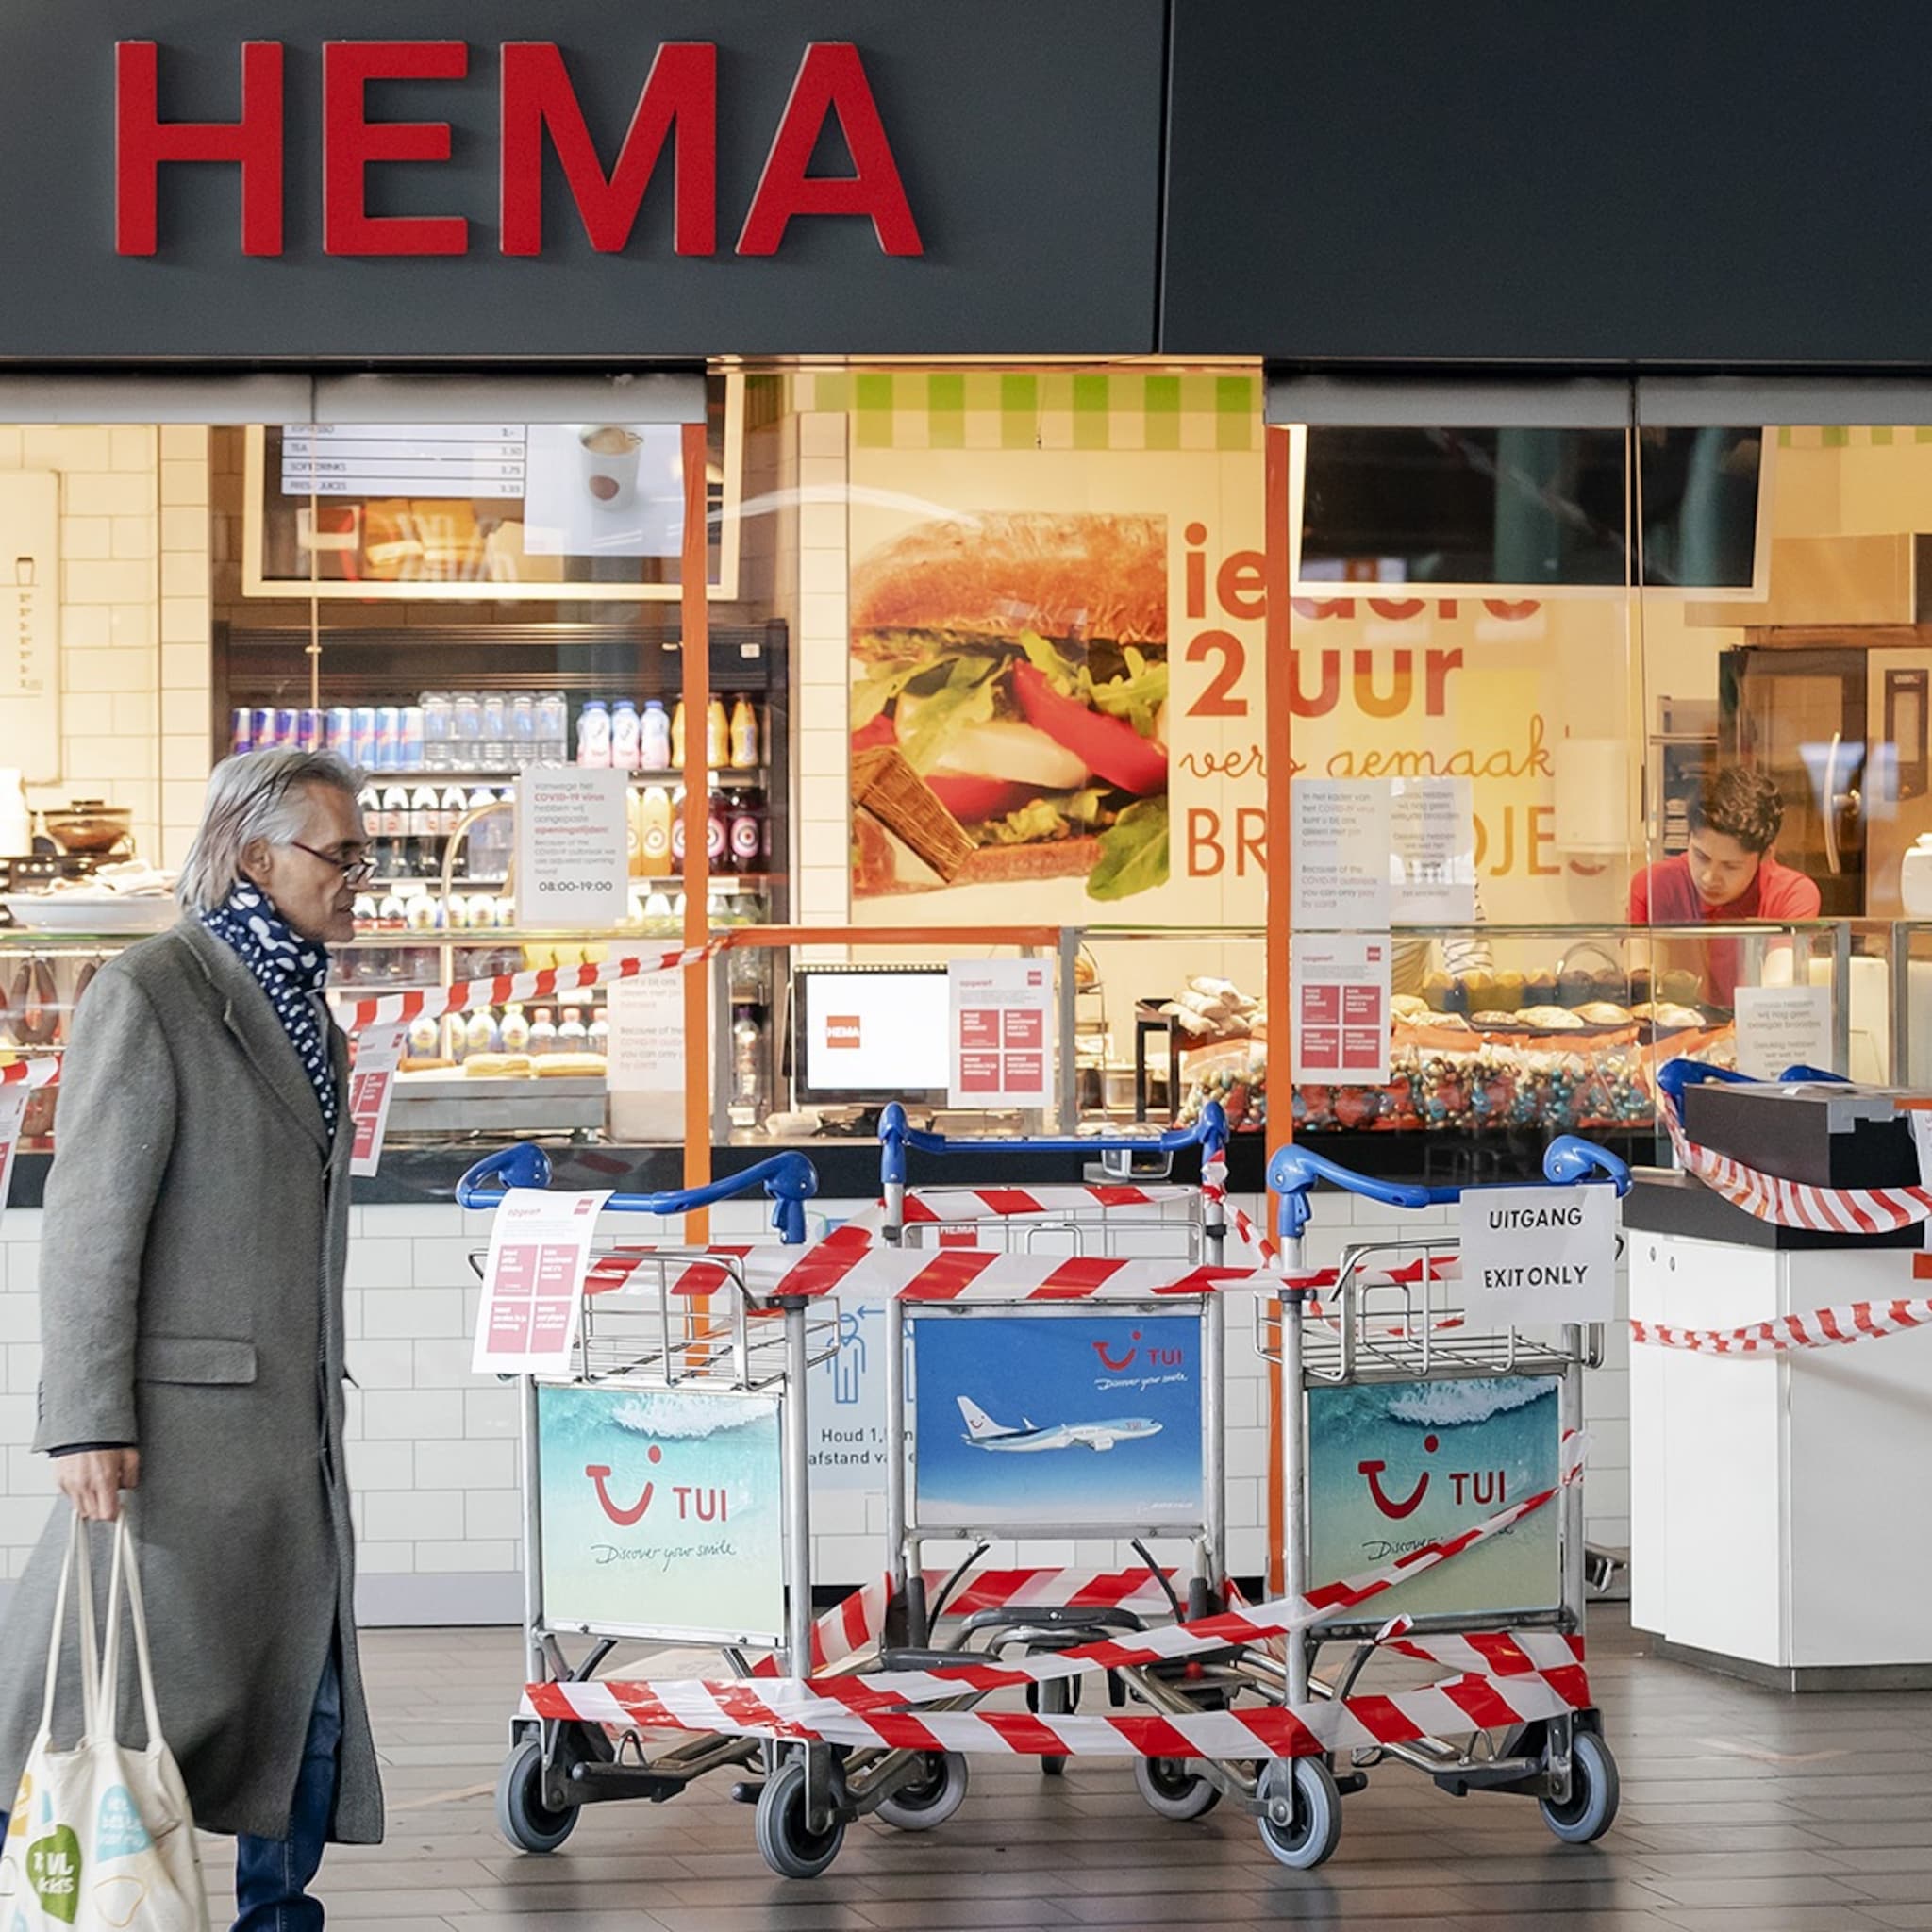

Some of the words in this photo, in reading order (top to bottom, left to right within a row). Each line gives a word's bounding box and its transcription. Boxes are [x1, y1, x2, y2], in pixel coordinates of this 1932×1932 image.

[115, 41, 924, 257] HEMA
[1185, 629, 1248, 717] 2
[1289, 647, 1464, 718] uur
[1327, 713, 1569, 778] gemaak
[539, 880, 613, 892] 08:00-19:00
[1489, 1207, 1583, 1229] UITGANG
[1484, 1268, 1524, 1288] EXIT
[1527, 1265, 1588, 1286] ONLY
[1147, 1348, 1182, 1366] TUI
[821, 1427, 864, 1443] Houd
[808, 1450, 870, 1465] afstand
[1449, 1471, 1506, 1506] TUI
[672, 1486, 727, 1522] TUI
[591, 1544, 661, 1565] Discover
[662, 1547, 694, 1574] your
[695, 1539, 737, 1557] smile
